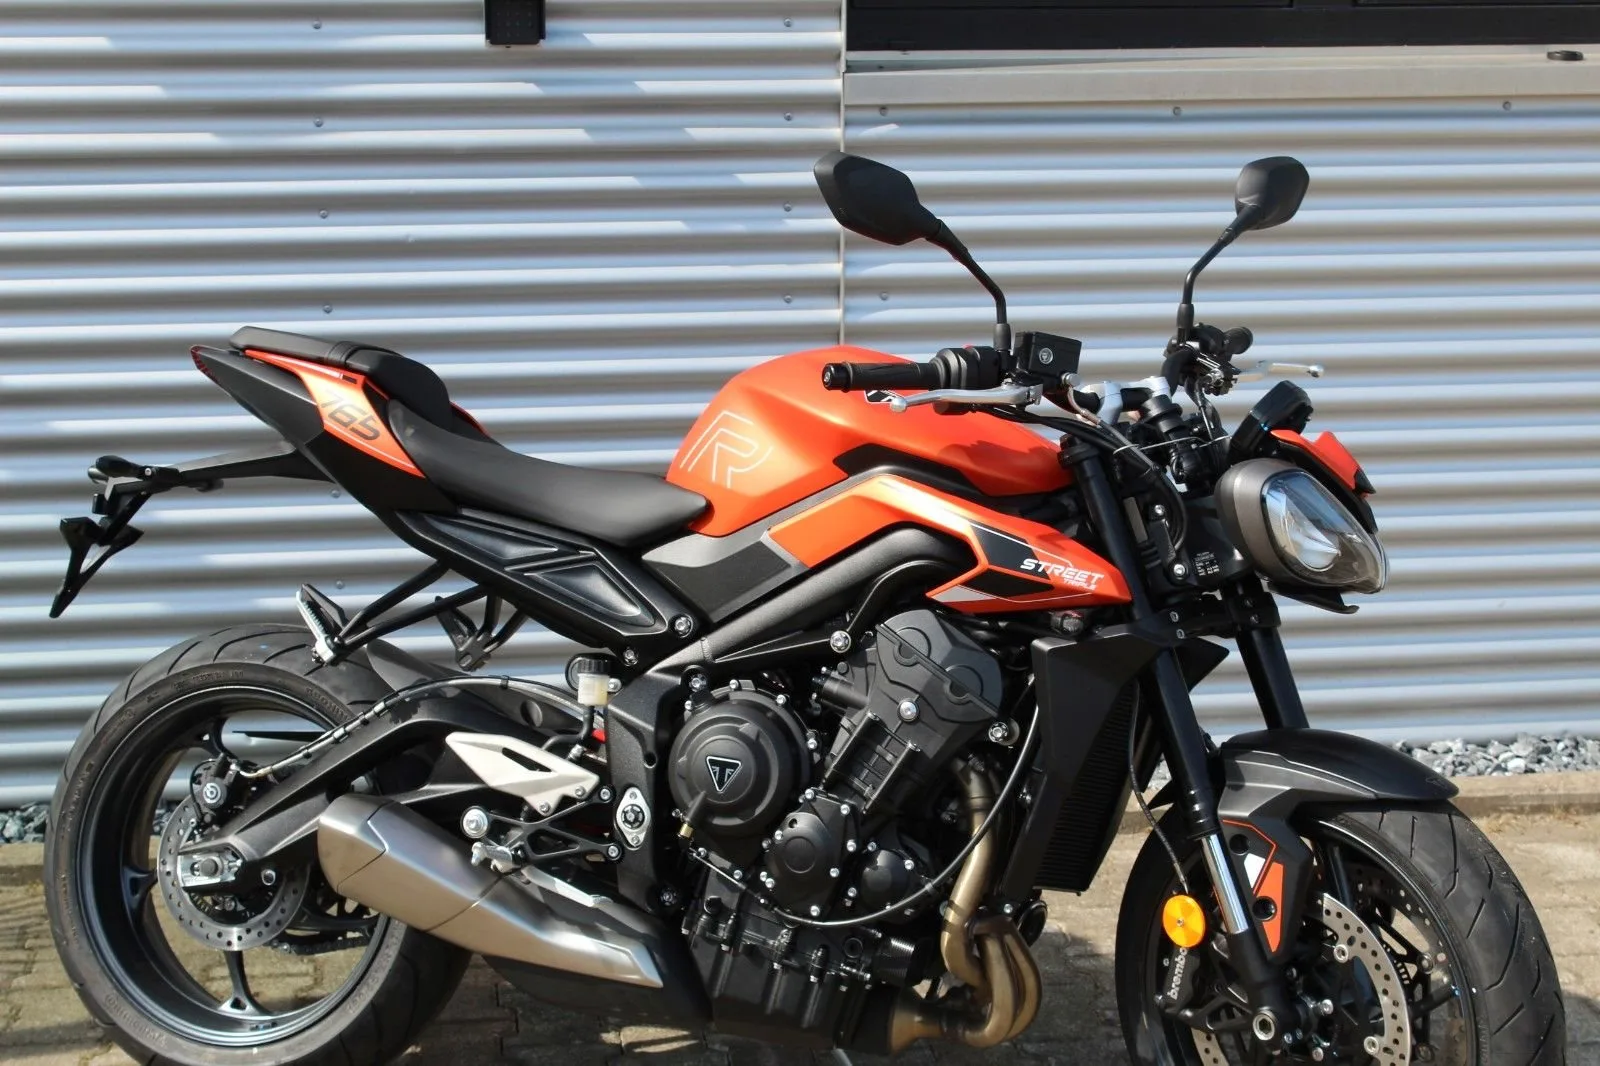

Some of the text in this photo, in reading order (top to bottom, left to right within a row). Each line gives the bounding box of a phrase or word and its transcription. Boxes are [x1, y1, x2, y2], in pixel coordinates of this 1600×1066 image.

[320, 389, 381, 441] 765
[679, 410, 774, 489] R
[1020, 558, 1104, 583] STREET
[1063, 577, 1097, 591] TRIPLE
[1167, 947, 1188, 1000] brembo
